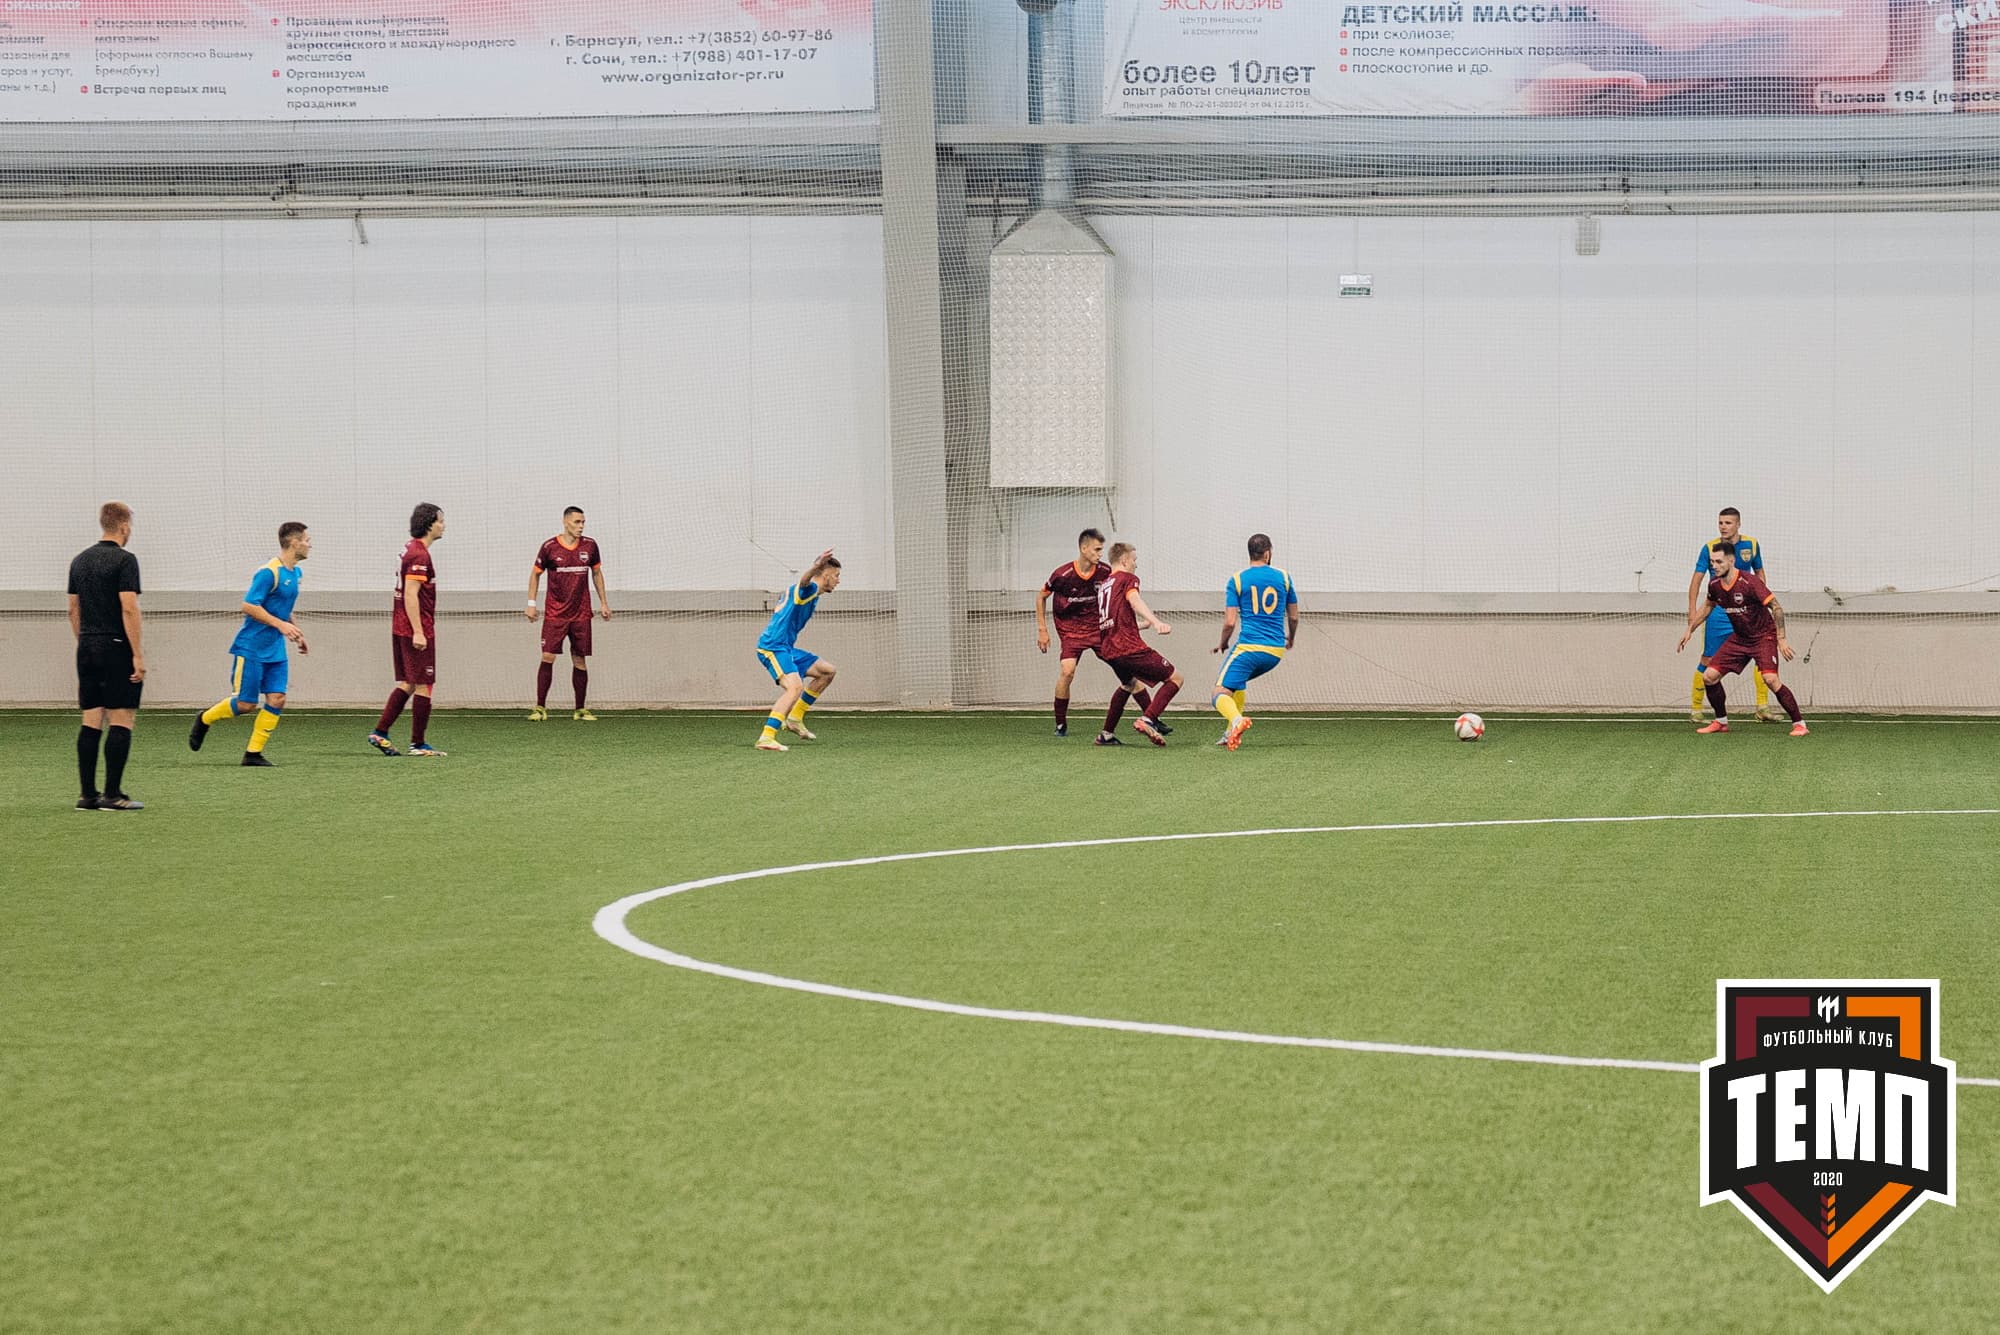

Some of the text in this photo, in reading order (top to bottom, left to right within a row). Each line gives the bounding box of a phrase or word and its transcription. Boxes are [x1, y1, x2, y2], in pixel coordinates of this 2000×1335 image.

[1341, 0, 1464, 27] ДЕТСКИЙ
[565, 34, 642, 48] Барнаул,
[687, 30, 758, 45] +7(3852)
[1352, 29, 1455, 41] при сколиозе;
[286, 51, 352, 62] масштаба
[582, 52, 625, 66] Сочи,
[631, 52, 668, 64] тел.:
[671, 49, 732, 65] +7(988)
[736, 47, 818, 62] 401-17-07
[1352, 46, 1395, 58] после
[1399, 45, 1524, 57] компрессионных
[286, 69, 366, 82] Организуем
[601, 67, 784, 84] www.organizator-pr.ru
[1123, 59, 1316, 85] более 10лет
[1352, 62, 1453, 74] плоскостопие
[1470, 62, 1493, 76] др.
[94, 84, 227, 96] Встреча первых лиц
[286, 83, 389, 95] корпоративные
[1122, 84, 1311, 98] опыт работы специалистов
[1820, 91, 1886, 104] Попова
[1894, 90, 1927, 102] 194
[287, 99, 357, 110] праздники
[1250, 585, 1279, 615] 10
